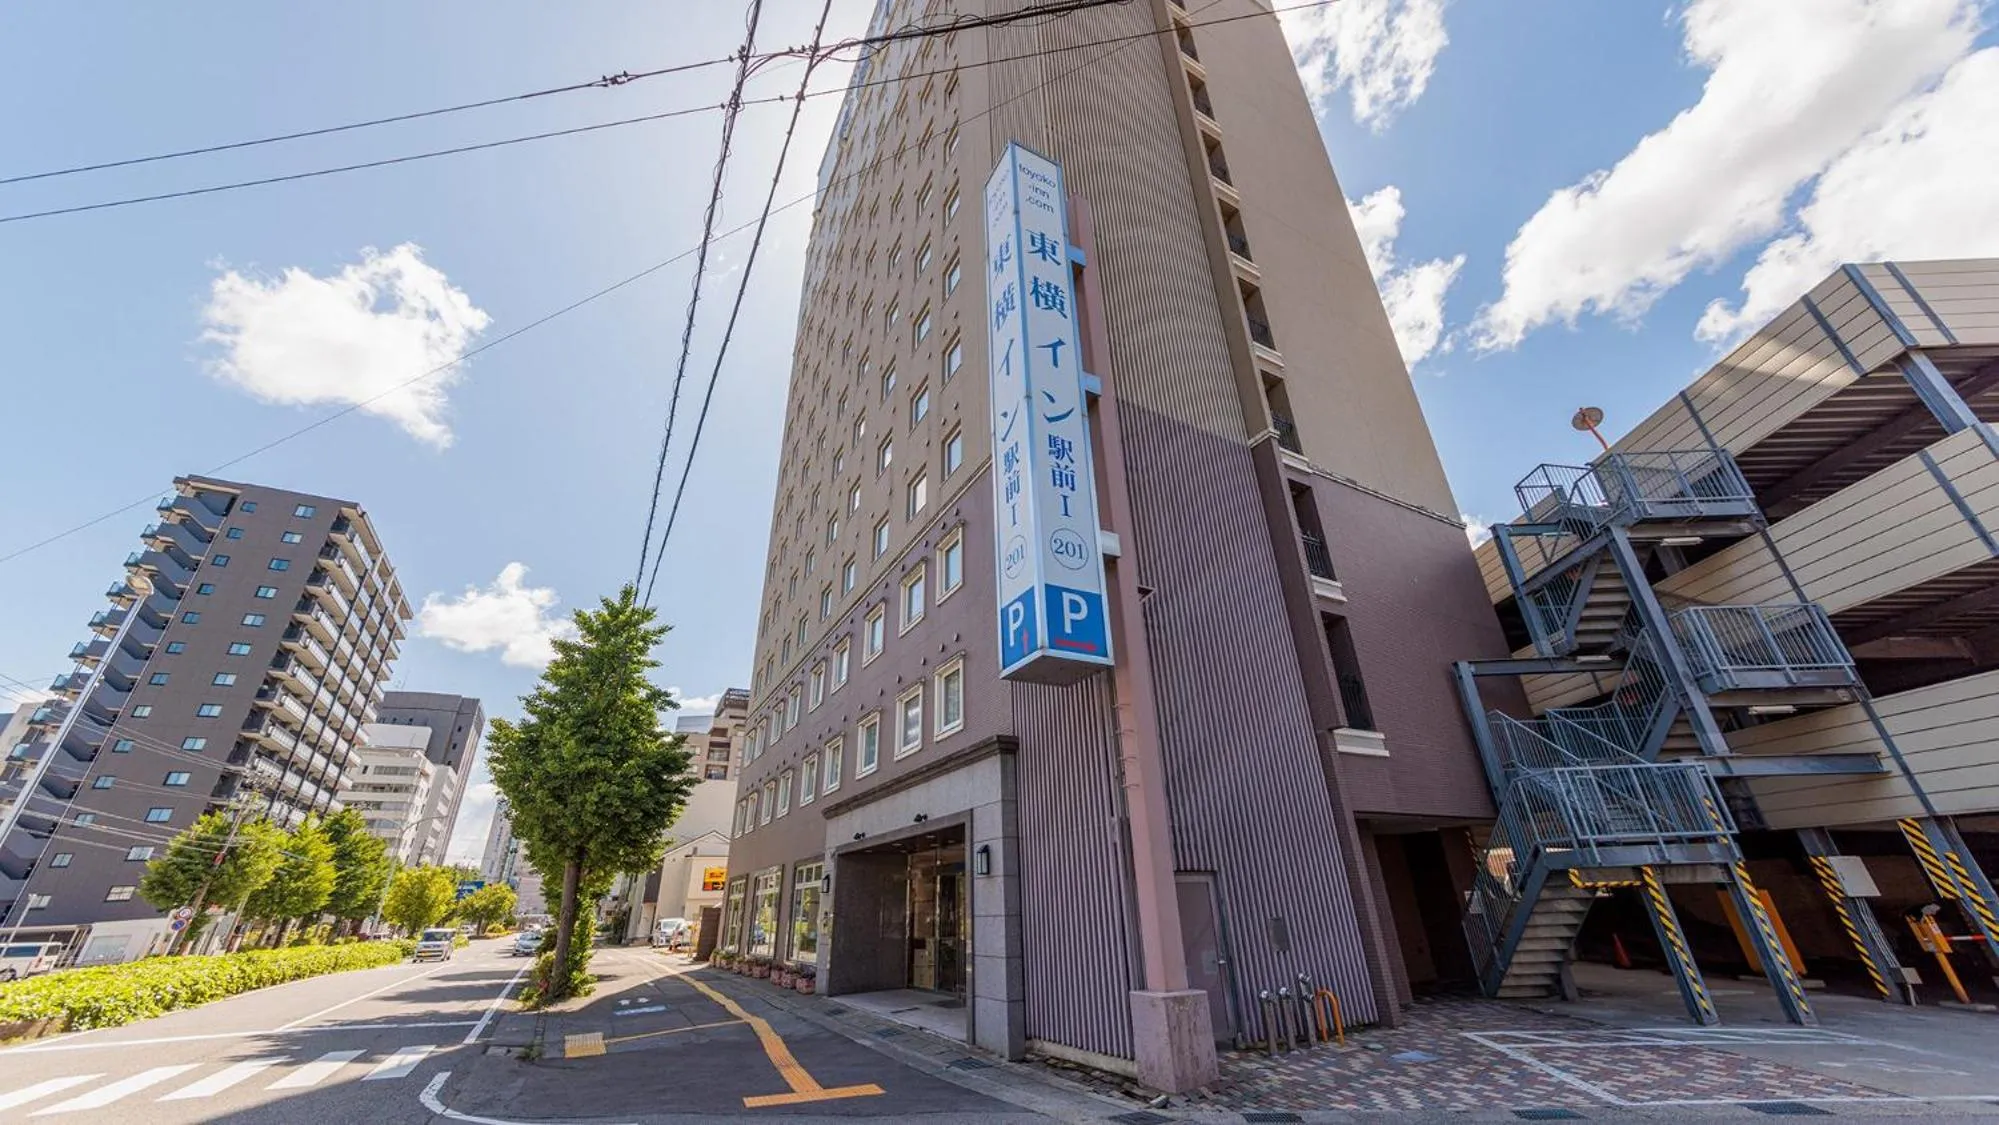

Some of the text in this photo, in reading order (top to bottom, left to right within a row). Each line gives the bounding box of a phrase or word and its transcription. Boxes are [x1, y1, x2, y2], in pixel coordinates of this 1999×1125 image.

[1019, 163, 1056, 189] toyoko
[1006, 545, 1025, 571] 201
[1053, 538, 1083, 560] 201
[1008, 601, 1024, 648] P
[1062, 591, 1088, 634] P
